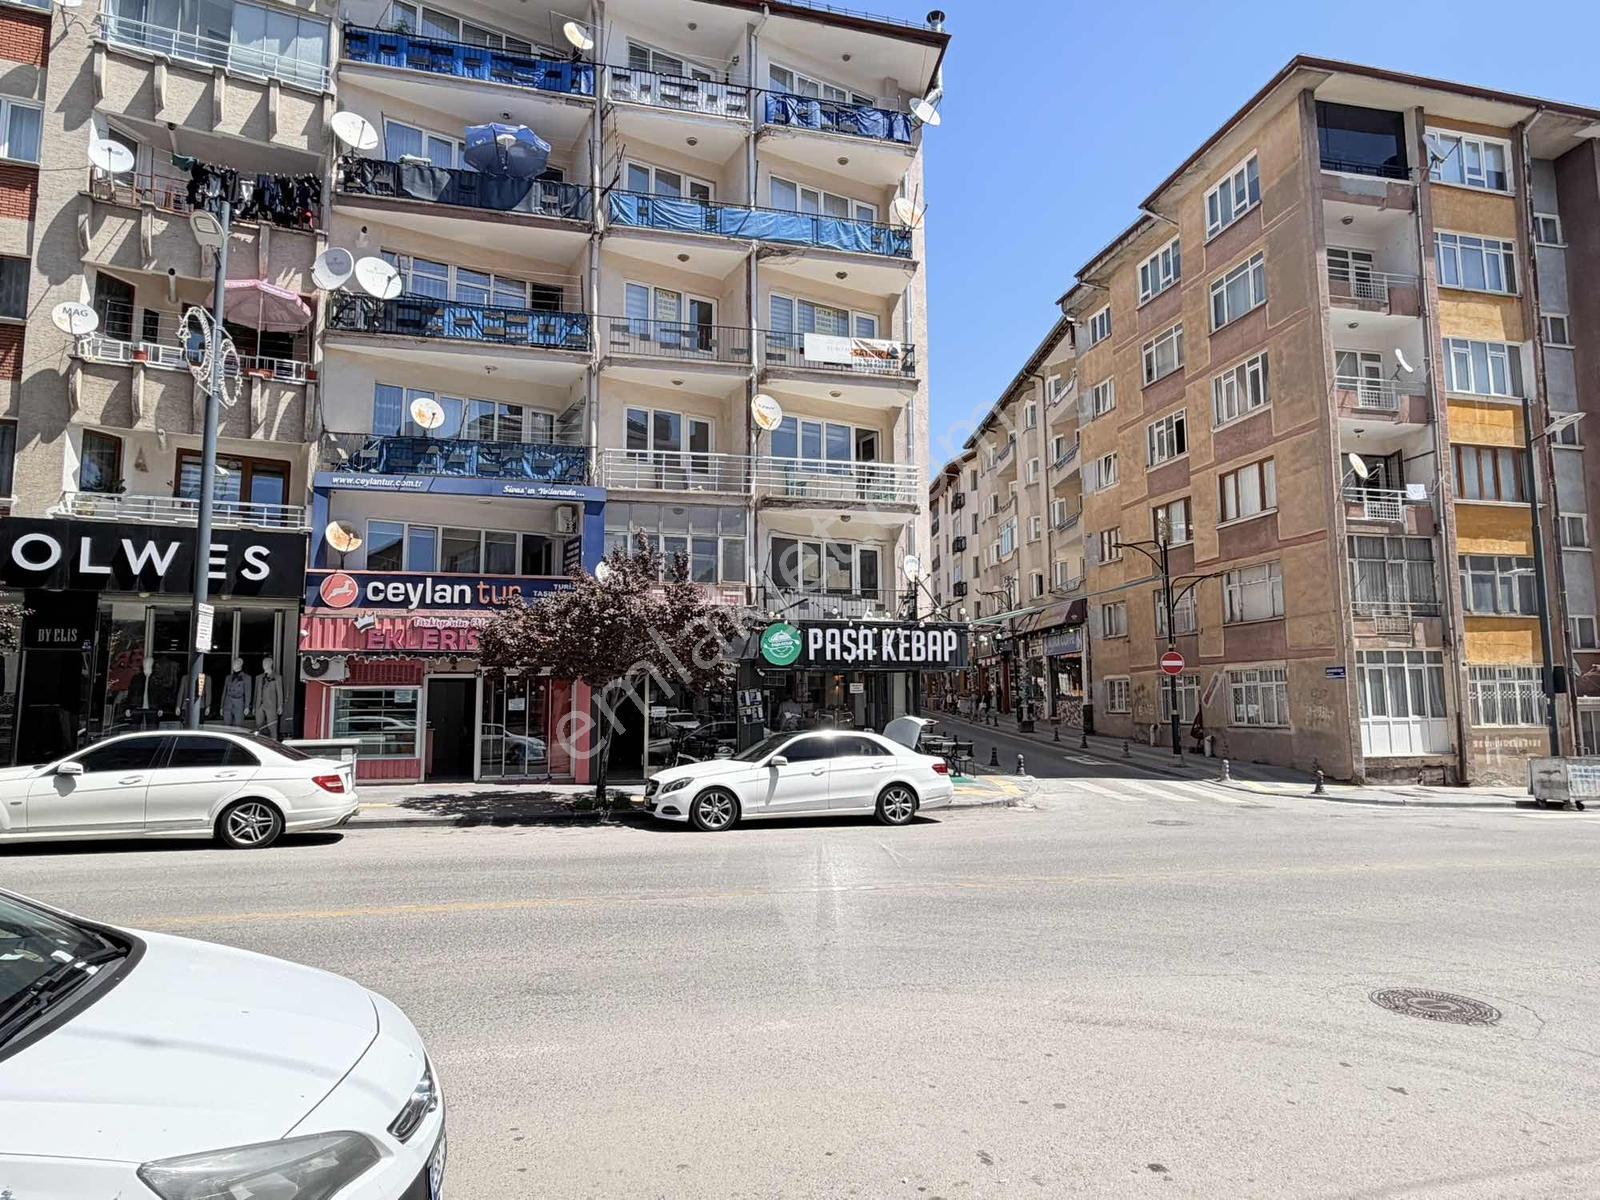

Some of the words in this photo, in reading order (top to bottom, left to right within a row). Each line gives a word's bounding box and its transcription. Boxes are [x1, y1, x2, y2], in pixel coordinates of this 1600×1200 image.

[62, 306, 88, 317] MAG
[332, 475, 423, 488] www.ceylantur.com.tr
[11, 532, 271, 582] OLWES
[367, 577, 471, 610] ceylan
[477, 580, 521, 605] tur
[37, 628, 51, 642] BY
[808, 628, 873, 664] PAŞA
[882, 628, 957, 662] KEBAP
